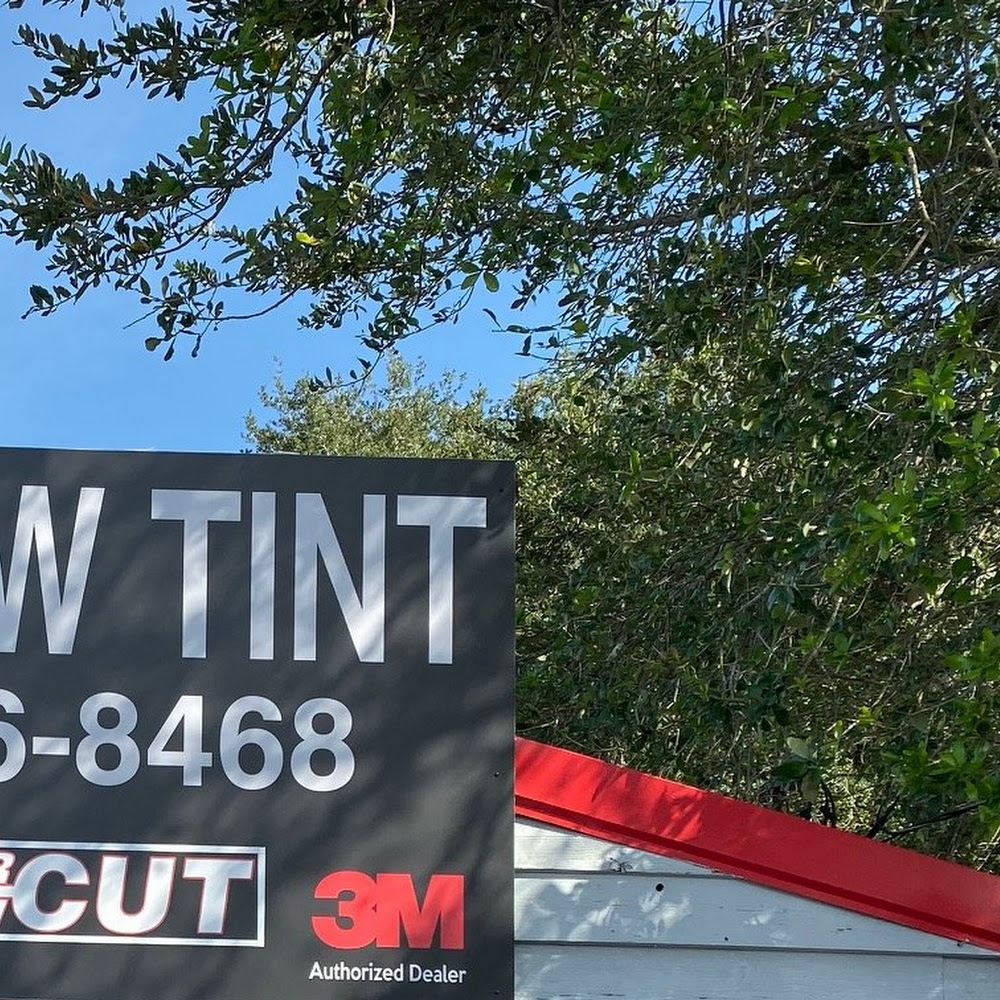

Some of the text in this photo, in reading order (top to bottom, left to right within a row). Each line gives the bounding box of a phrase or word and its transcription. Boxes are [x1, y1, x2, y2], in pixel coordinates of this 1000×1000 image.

[150, 488, 488, 665] TINT
[11, 853, 254, 936] CUT
[311, 870, 465, 950] 3M
[308, 961, 467, 983] Authorized Dealer
